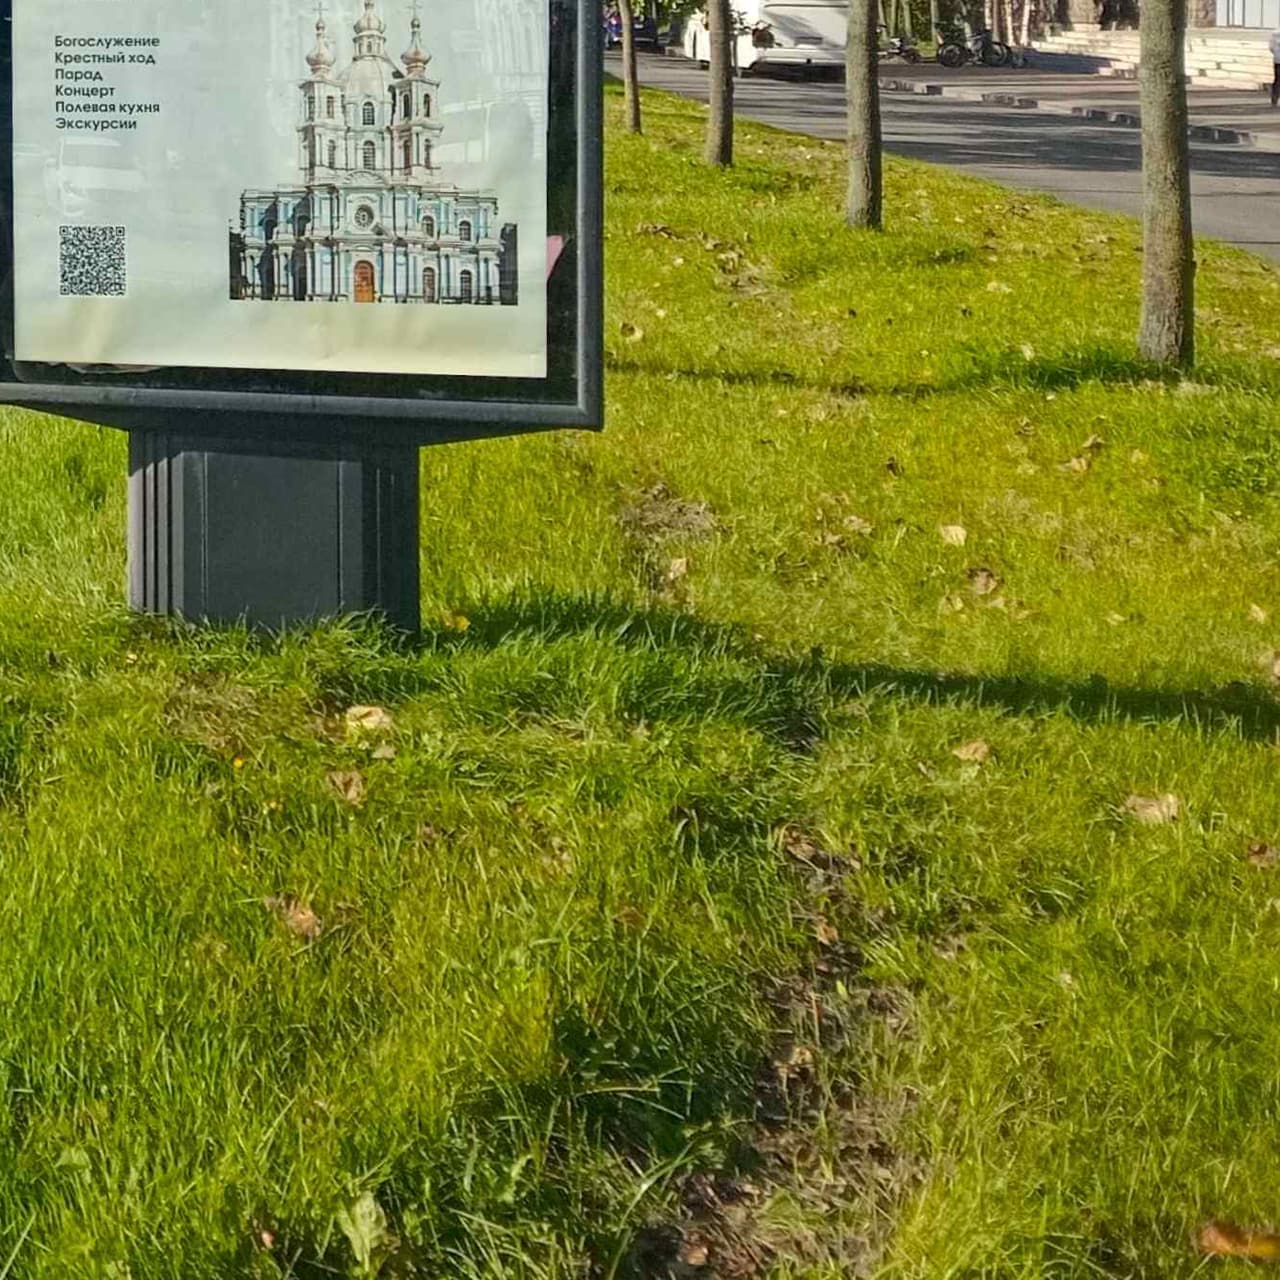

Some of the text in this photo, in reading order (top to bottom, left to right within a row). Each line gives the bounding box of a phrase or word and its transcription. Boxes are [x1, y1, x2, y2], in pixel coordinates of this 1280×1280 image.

[54, 34, 161, 50] Богослужение
[54, 51, 157, 66] Крестный ход
[54, 67, 104, 83] Парад
[55, 84, 116, 99] Концерт
[55, 100, 160, 116] Полевая кухня
[55, 116, 137, 132] Экскурсии
